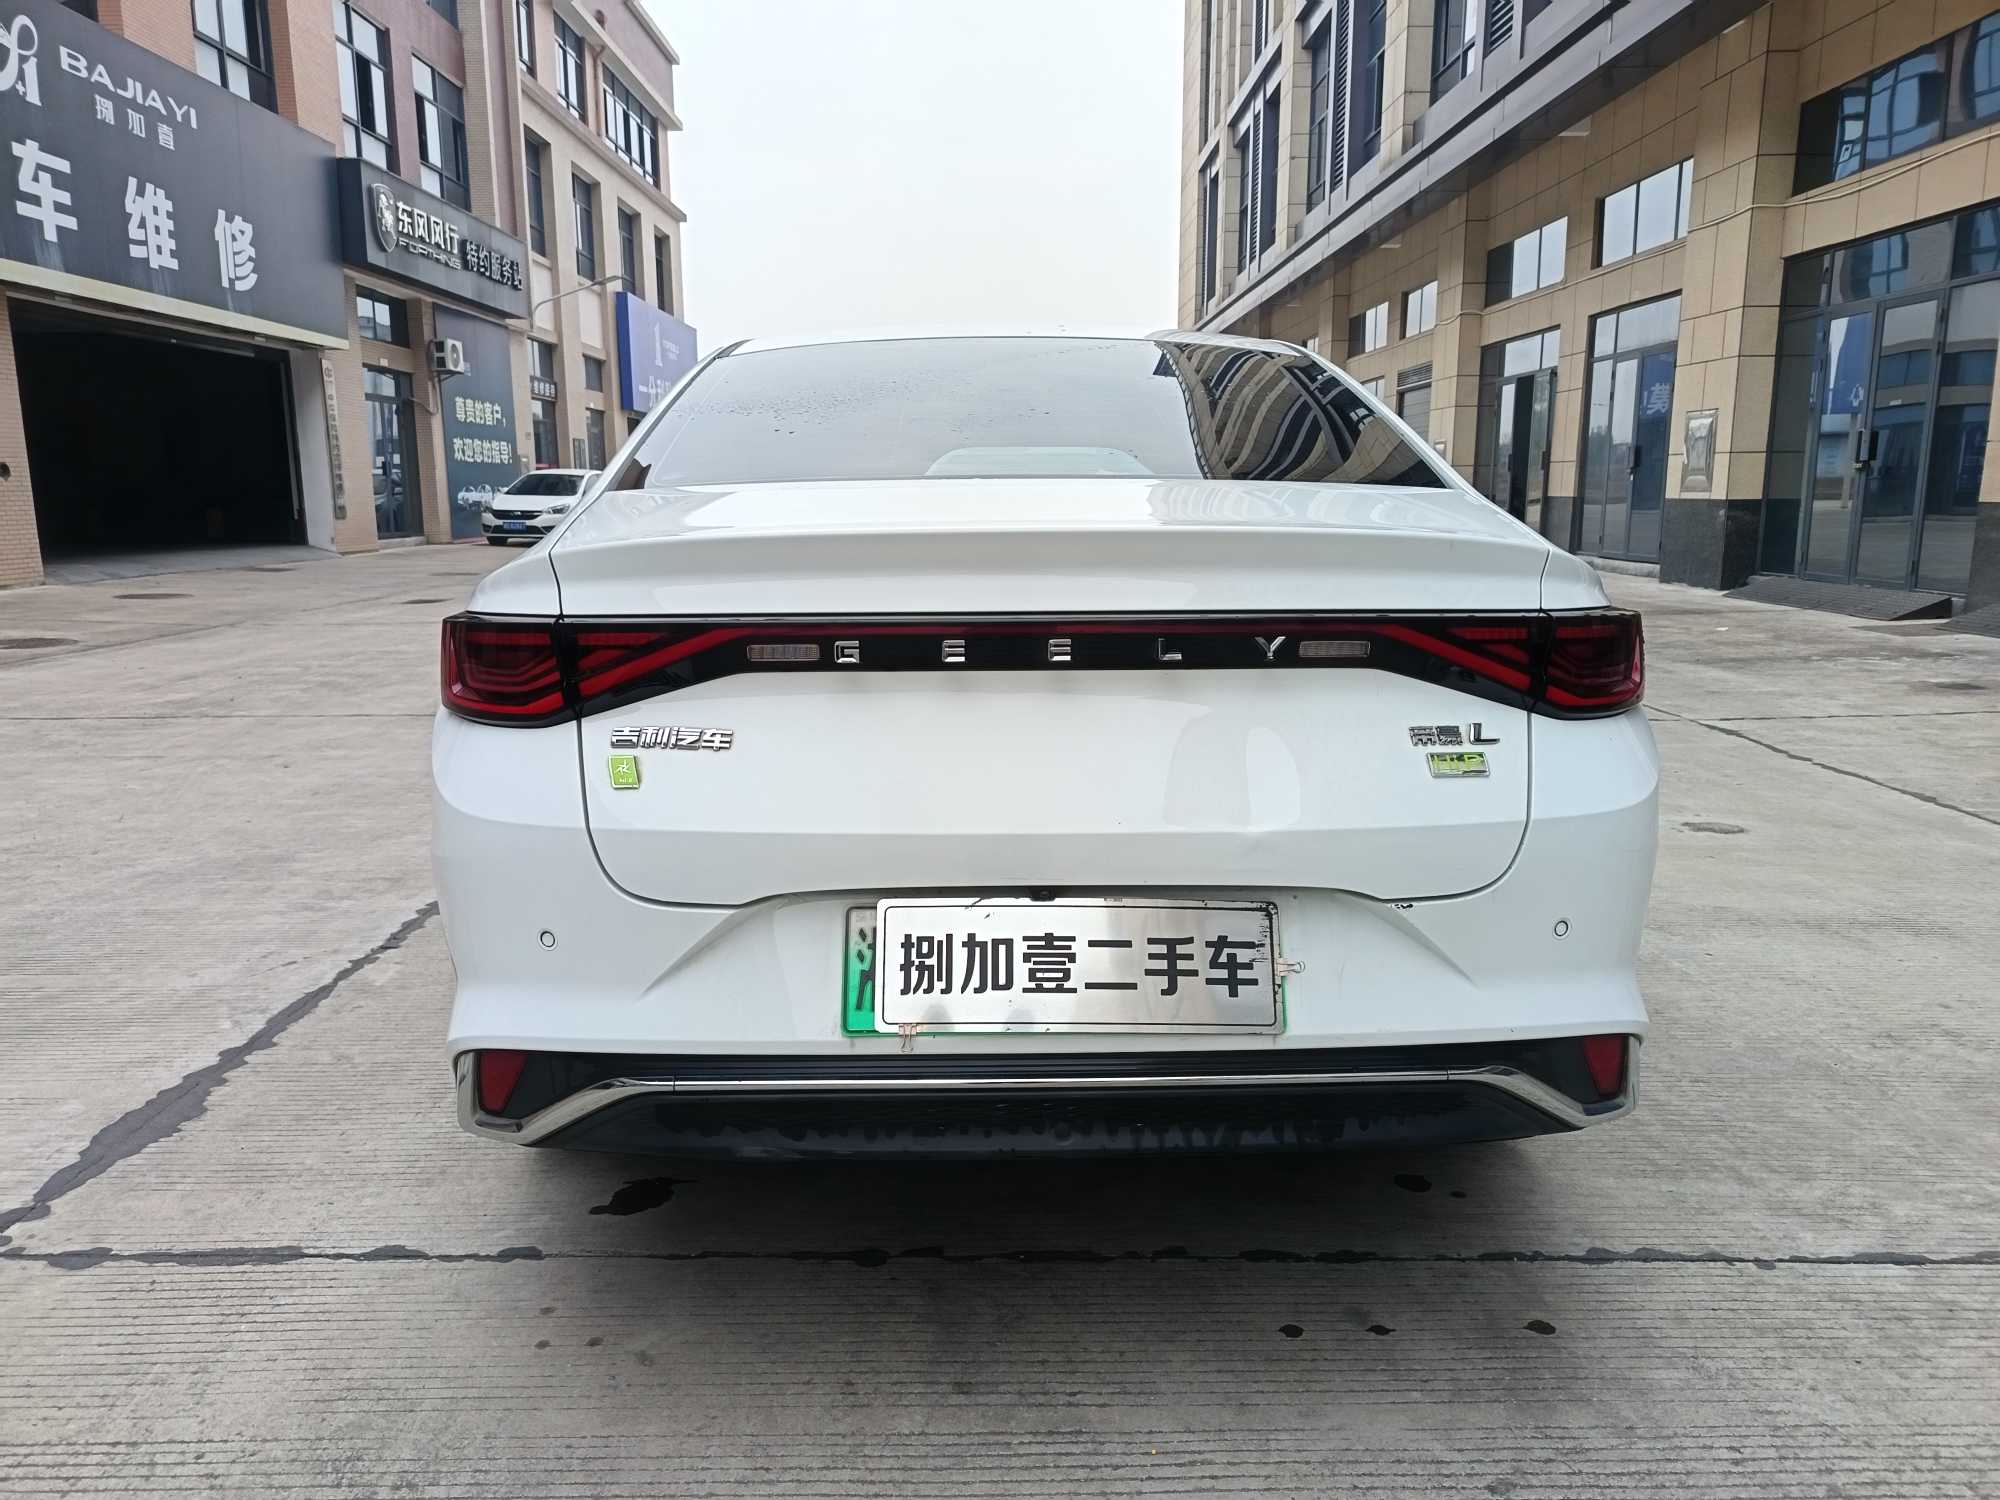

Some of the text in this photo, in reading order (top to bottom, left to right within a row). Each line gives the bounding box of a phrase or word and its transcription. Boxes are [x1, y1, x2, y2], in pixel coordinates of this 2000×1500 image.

[59, 45, 198, 130] BAJIAYI
[10, 138, 258, 292] 车维修
[396, 201, 460, 255] 东风风行
[398, 236, 462, 271] FORTHING
[464, 239, 524, 290] 特约服务站
[834, 635, 1287, 665] GEELY
[610, 726, 734, 752] 吉利汽车
[899, 932, 1259, 999] 捌加壹二手车
